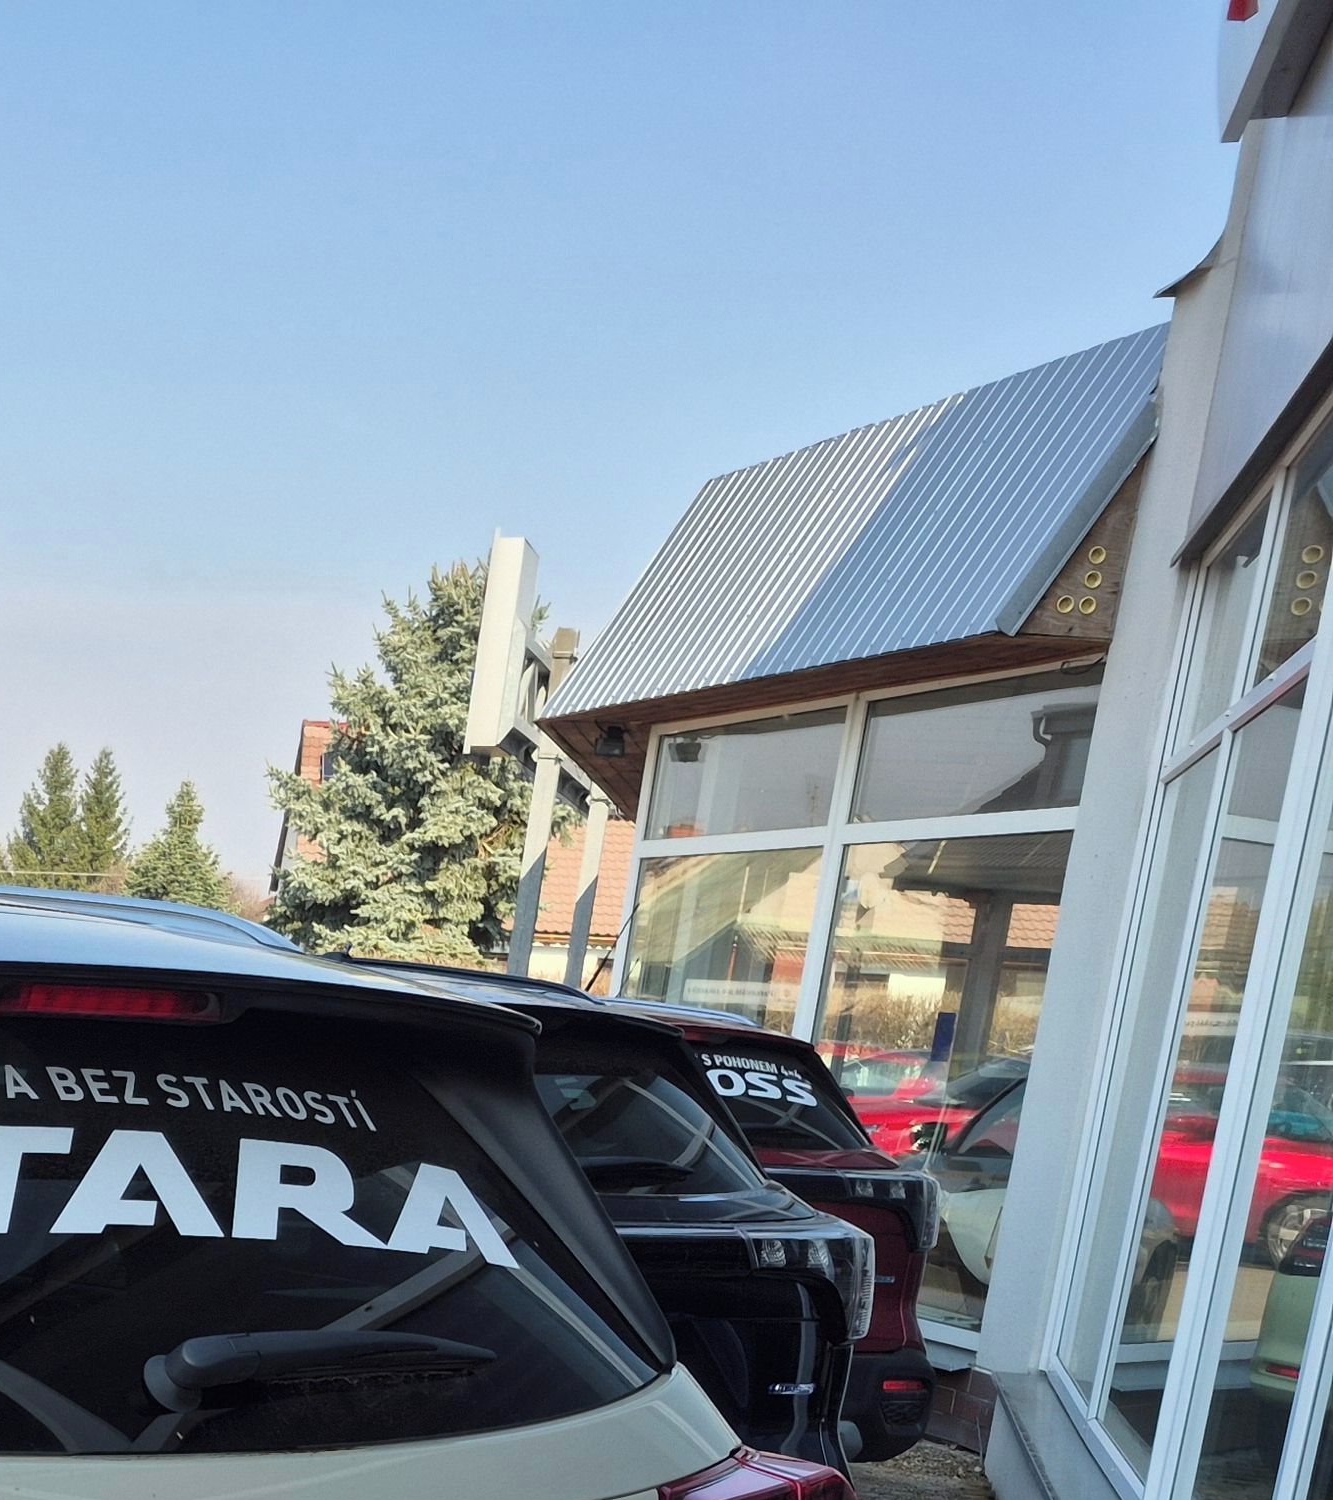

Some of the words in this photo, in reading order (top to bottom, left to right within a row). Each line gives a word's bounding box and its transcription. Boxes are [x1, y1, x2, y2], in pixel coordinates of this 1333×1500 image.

[701, 1053, 712, 1067] S
[713, 1054, 778, 1075] POHONEM
[4, 1064, 40, 1100] A
[45, 1066, 150, 1106] BEZ
[156, 1072, 377, 1132] STAROSTÍ
